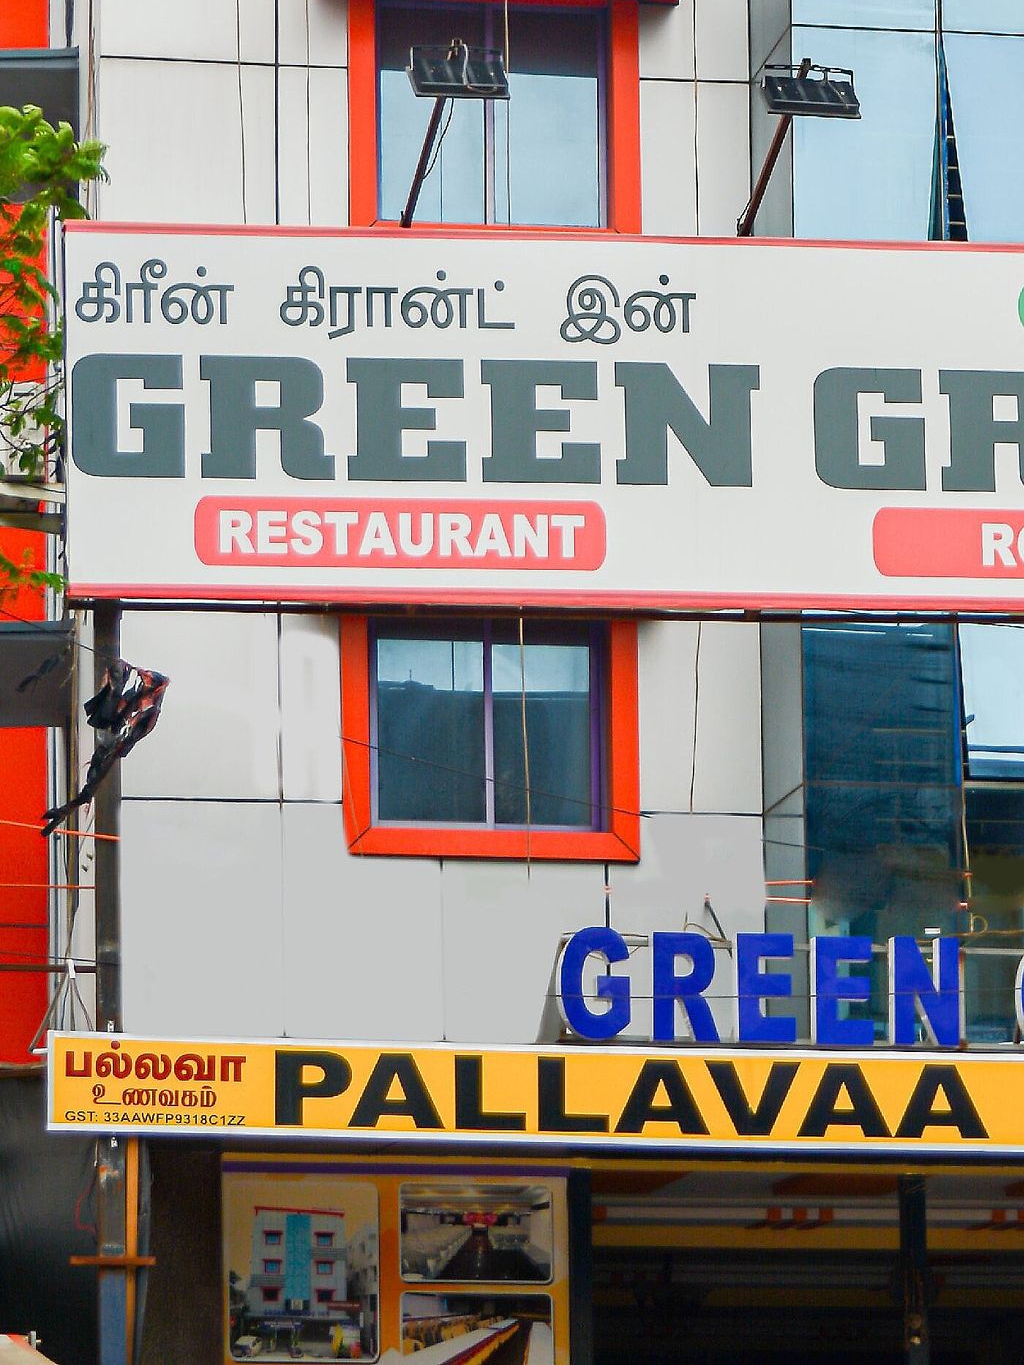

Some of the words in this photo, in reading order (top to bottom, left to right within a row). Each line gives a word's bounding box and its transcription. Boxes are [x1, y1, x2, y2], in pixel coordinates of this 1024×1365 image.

[560, 274, 697, 345] இன்
[72, 353, 760, 487] GREEN
[219, 510, 586, 559] RESTAURANT
[556, 926, 967, 1047] GREEN
[65, 1040, 247, 1082] பல்லவா
[65, 1111, 98, 1122] GST:
[92, 1084, 217, 1108] உணவகம்
[274, 1050, 989, 1140] PALLAVAA
